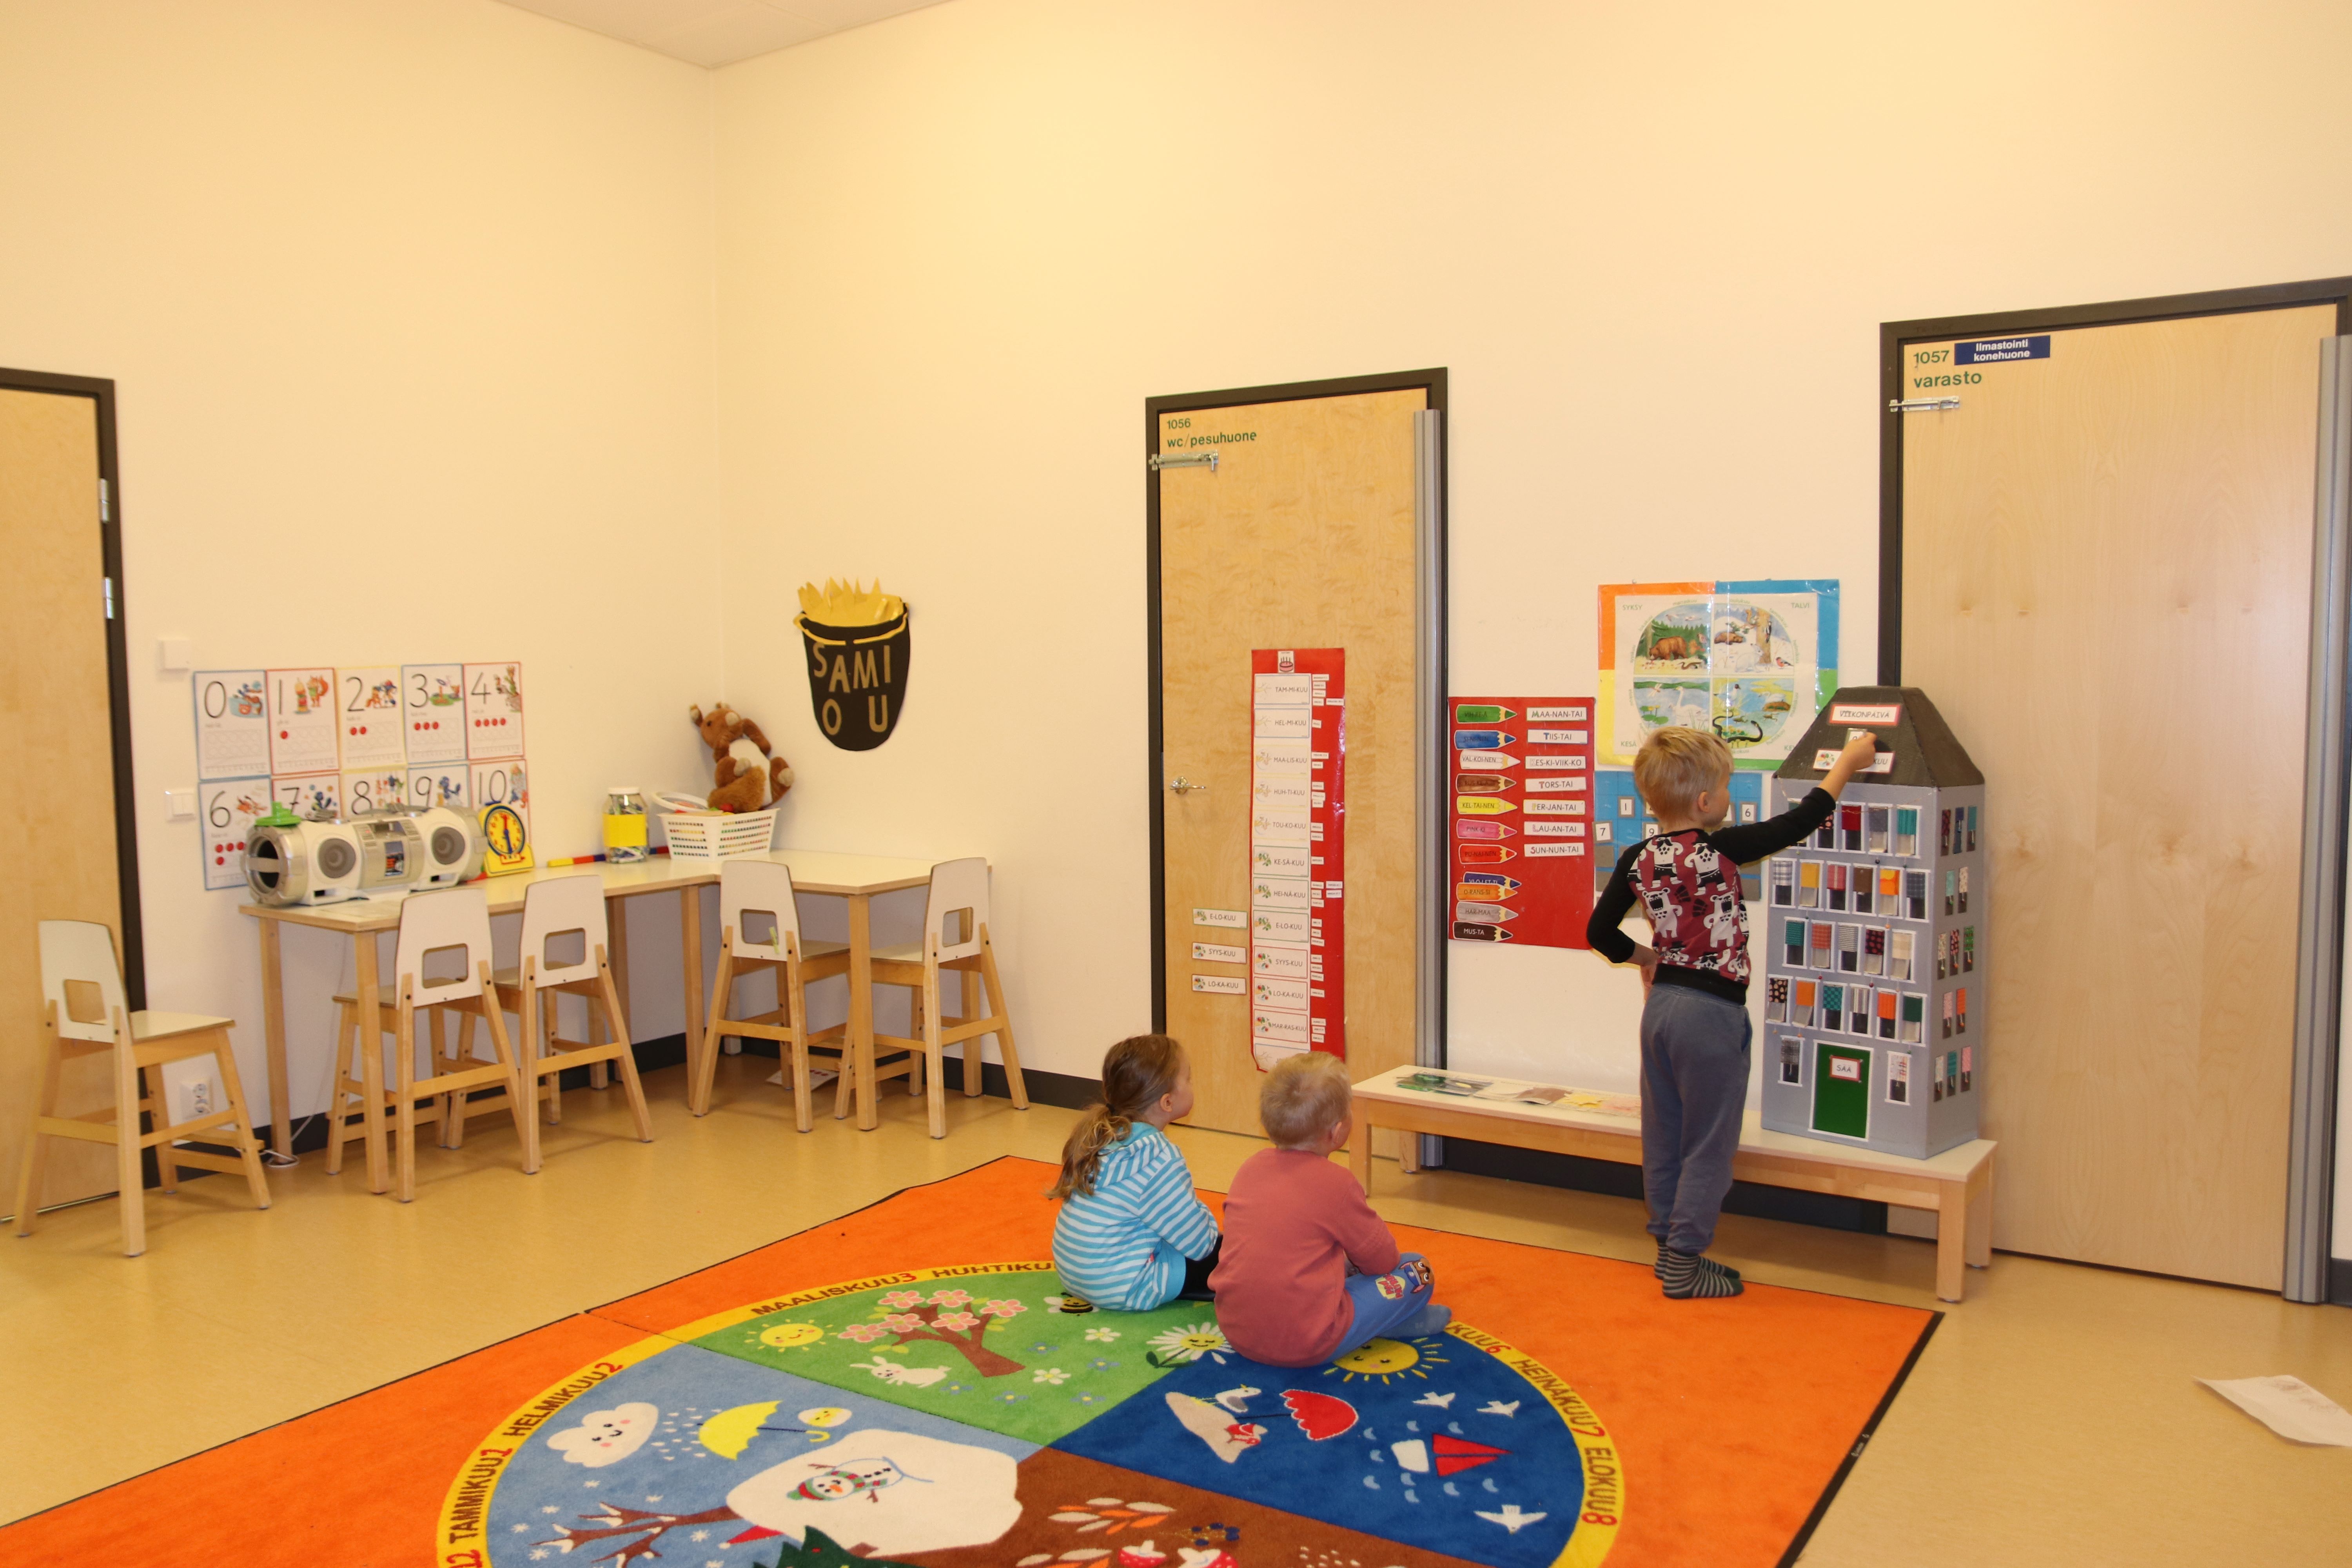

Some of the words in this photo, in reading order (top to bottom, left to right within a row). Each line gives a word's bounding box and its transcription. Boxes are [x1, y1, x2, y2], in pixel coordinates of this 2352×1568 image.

[1976, 339, 2029, 352] Ilmastointi
[1913, 350, 1949, 363] 1057
[1974, 350, 2031, 362] konehuone
[1914, 371, 1982, 388] varasto
[1167, 418, 1191, 429] 1056
[1167, 432, 1257, 448] wc/pesuhuone
[812, 641, 891, 693] SAMI
[346, 676, 365, 711] 2
[410, 673, 429, 708] 3
[471, 672, 491, 704] 4
[205, 681, 226, 718] 0
[279, 679, 282, 715] 1
[822, 699, 842, 735] O
[868, 695, 888, 733] U
[1543, 732, 1572, 740] TIIS-TAI
[415, 776, 432, 807] 9
[479, 769, 507, 804] 10
[1539, 780, 1573, 789] TORS-TAI
[281, 787, 300, 814] 7
[351, 780, 373, 815] 8
[210, 790, 230, 828] 6
[1745, 808, 1751, 817] 6
[1600, 828, 1606, 836] 7
[1649, 828, 1655, 837] 9
[1530, 846, 1579, 854] SUN-NUN-TAI
[1209, 949, 1236, 957] SYYS-KUU
[1275, 959, 1303, 967] SYYS-KUU
[1273, 991, 1304, 999] LO-KA-KUU
[1272, 1023, 1307, 1032] MAR-RAS-KUU
[932, 1262, 1055, 1278] HUHTIKU
